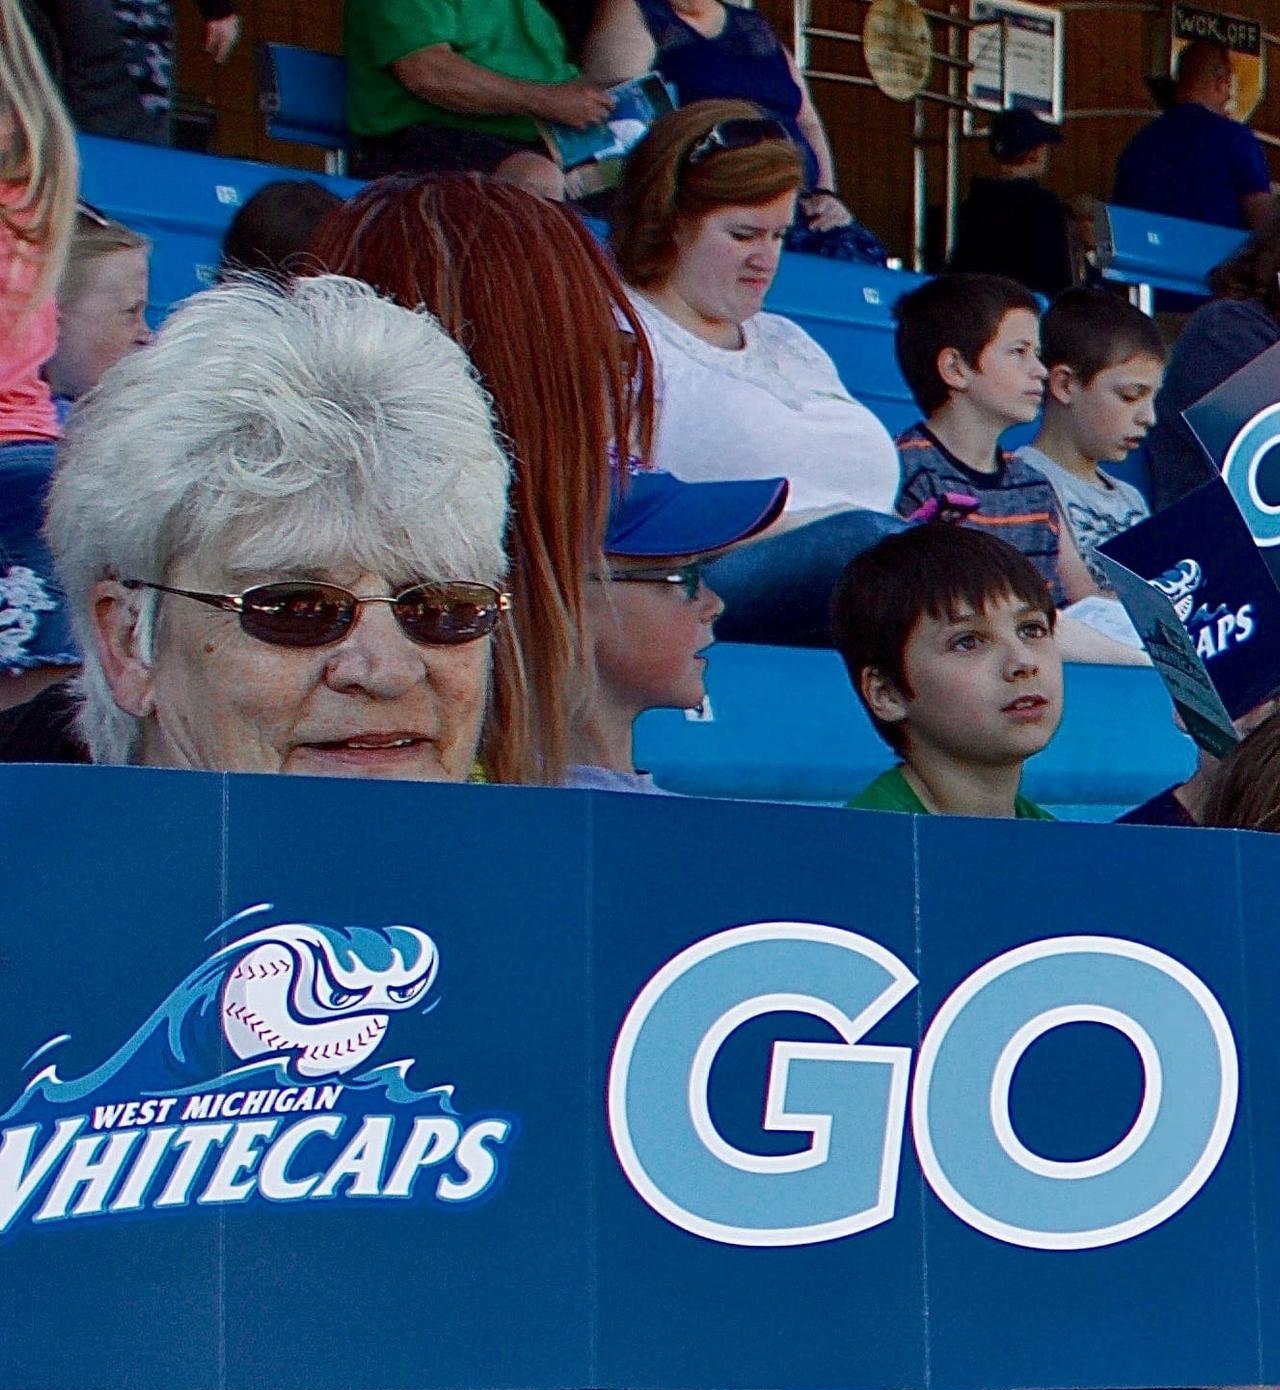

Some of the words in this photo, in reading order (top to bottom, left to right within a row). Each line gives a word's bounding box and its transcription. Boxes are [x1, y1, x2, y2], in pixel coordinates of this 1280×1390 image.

[92, 1097, 177, 1130] WEST
[181, 1084, 345, 1121] MICHIGAN
[610, 922, 1240, 1252] GO
[0, 1115, 511, 1233] WHITECAPS
